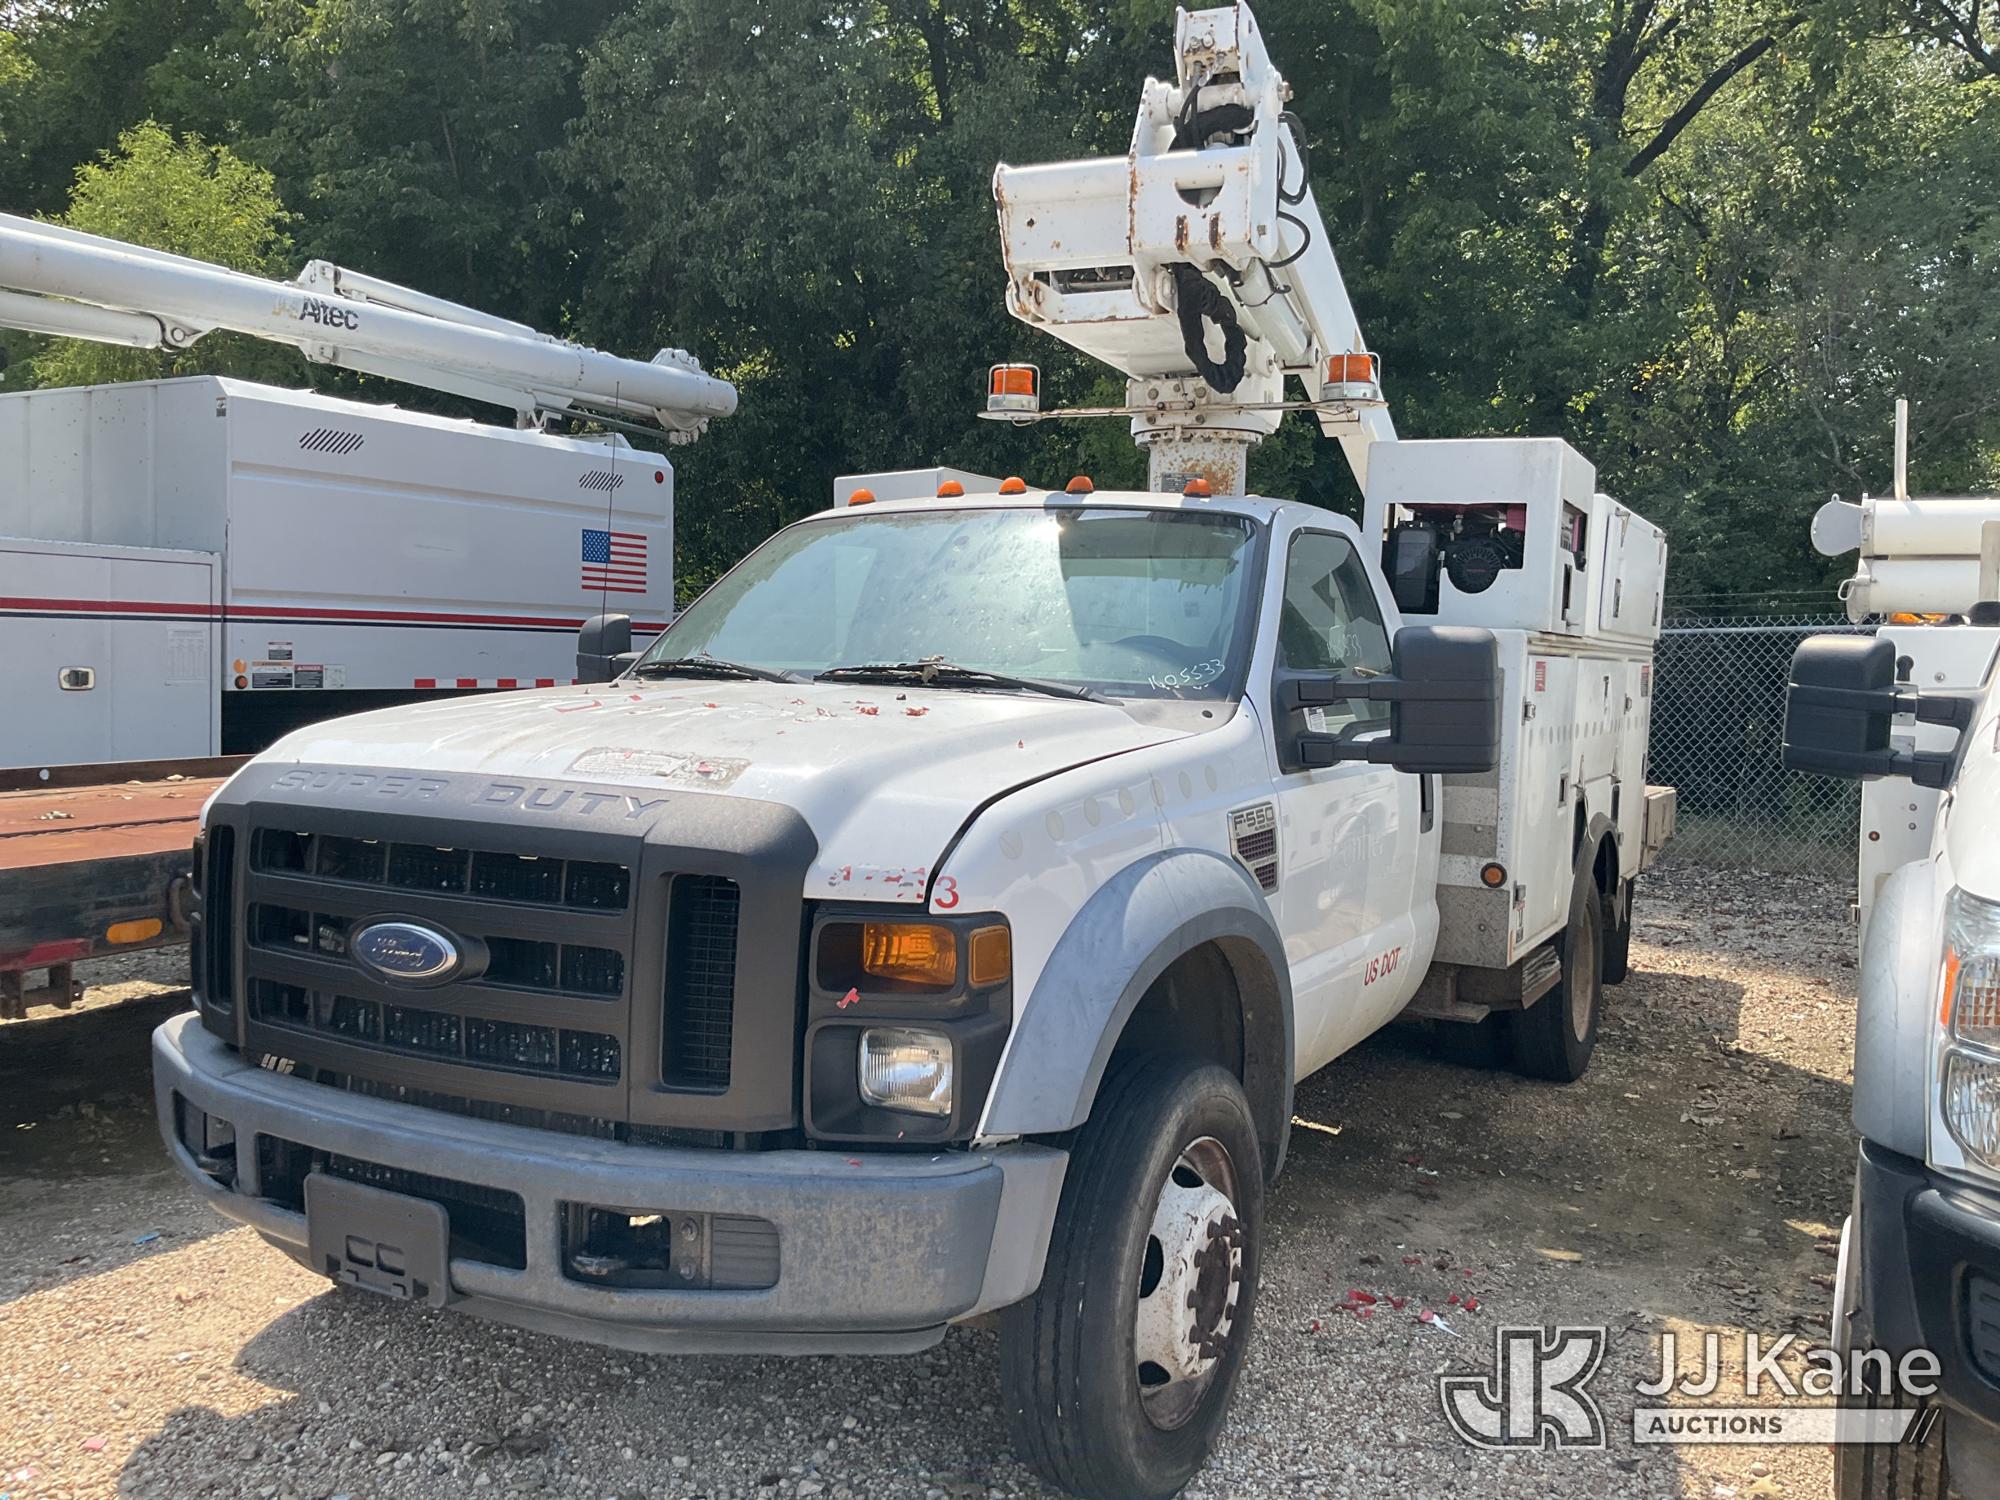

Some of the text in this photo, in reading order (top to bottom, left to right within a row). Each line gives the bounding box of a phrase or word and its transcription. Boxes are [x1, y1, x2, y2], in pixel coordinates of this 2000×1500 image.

[299, 296, 359, 330] Altec
[269, 769, 671, 820] SUPER DUTY
[1364, 946, 1401, 987] US DOT
